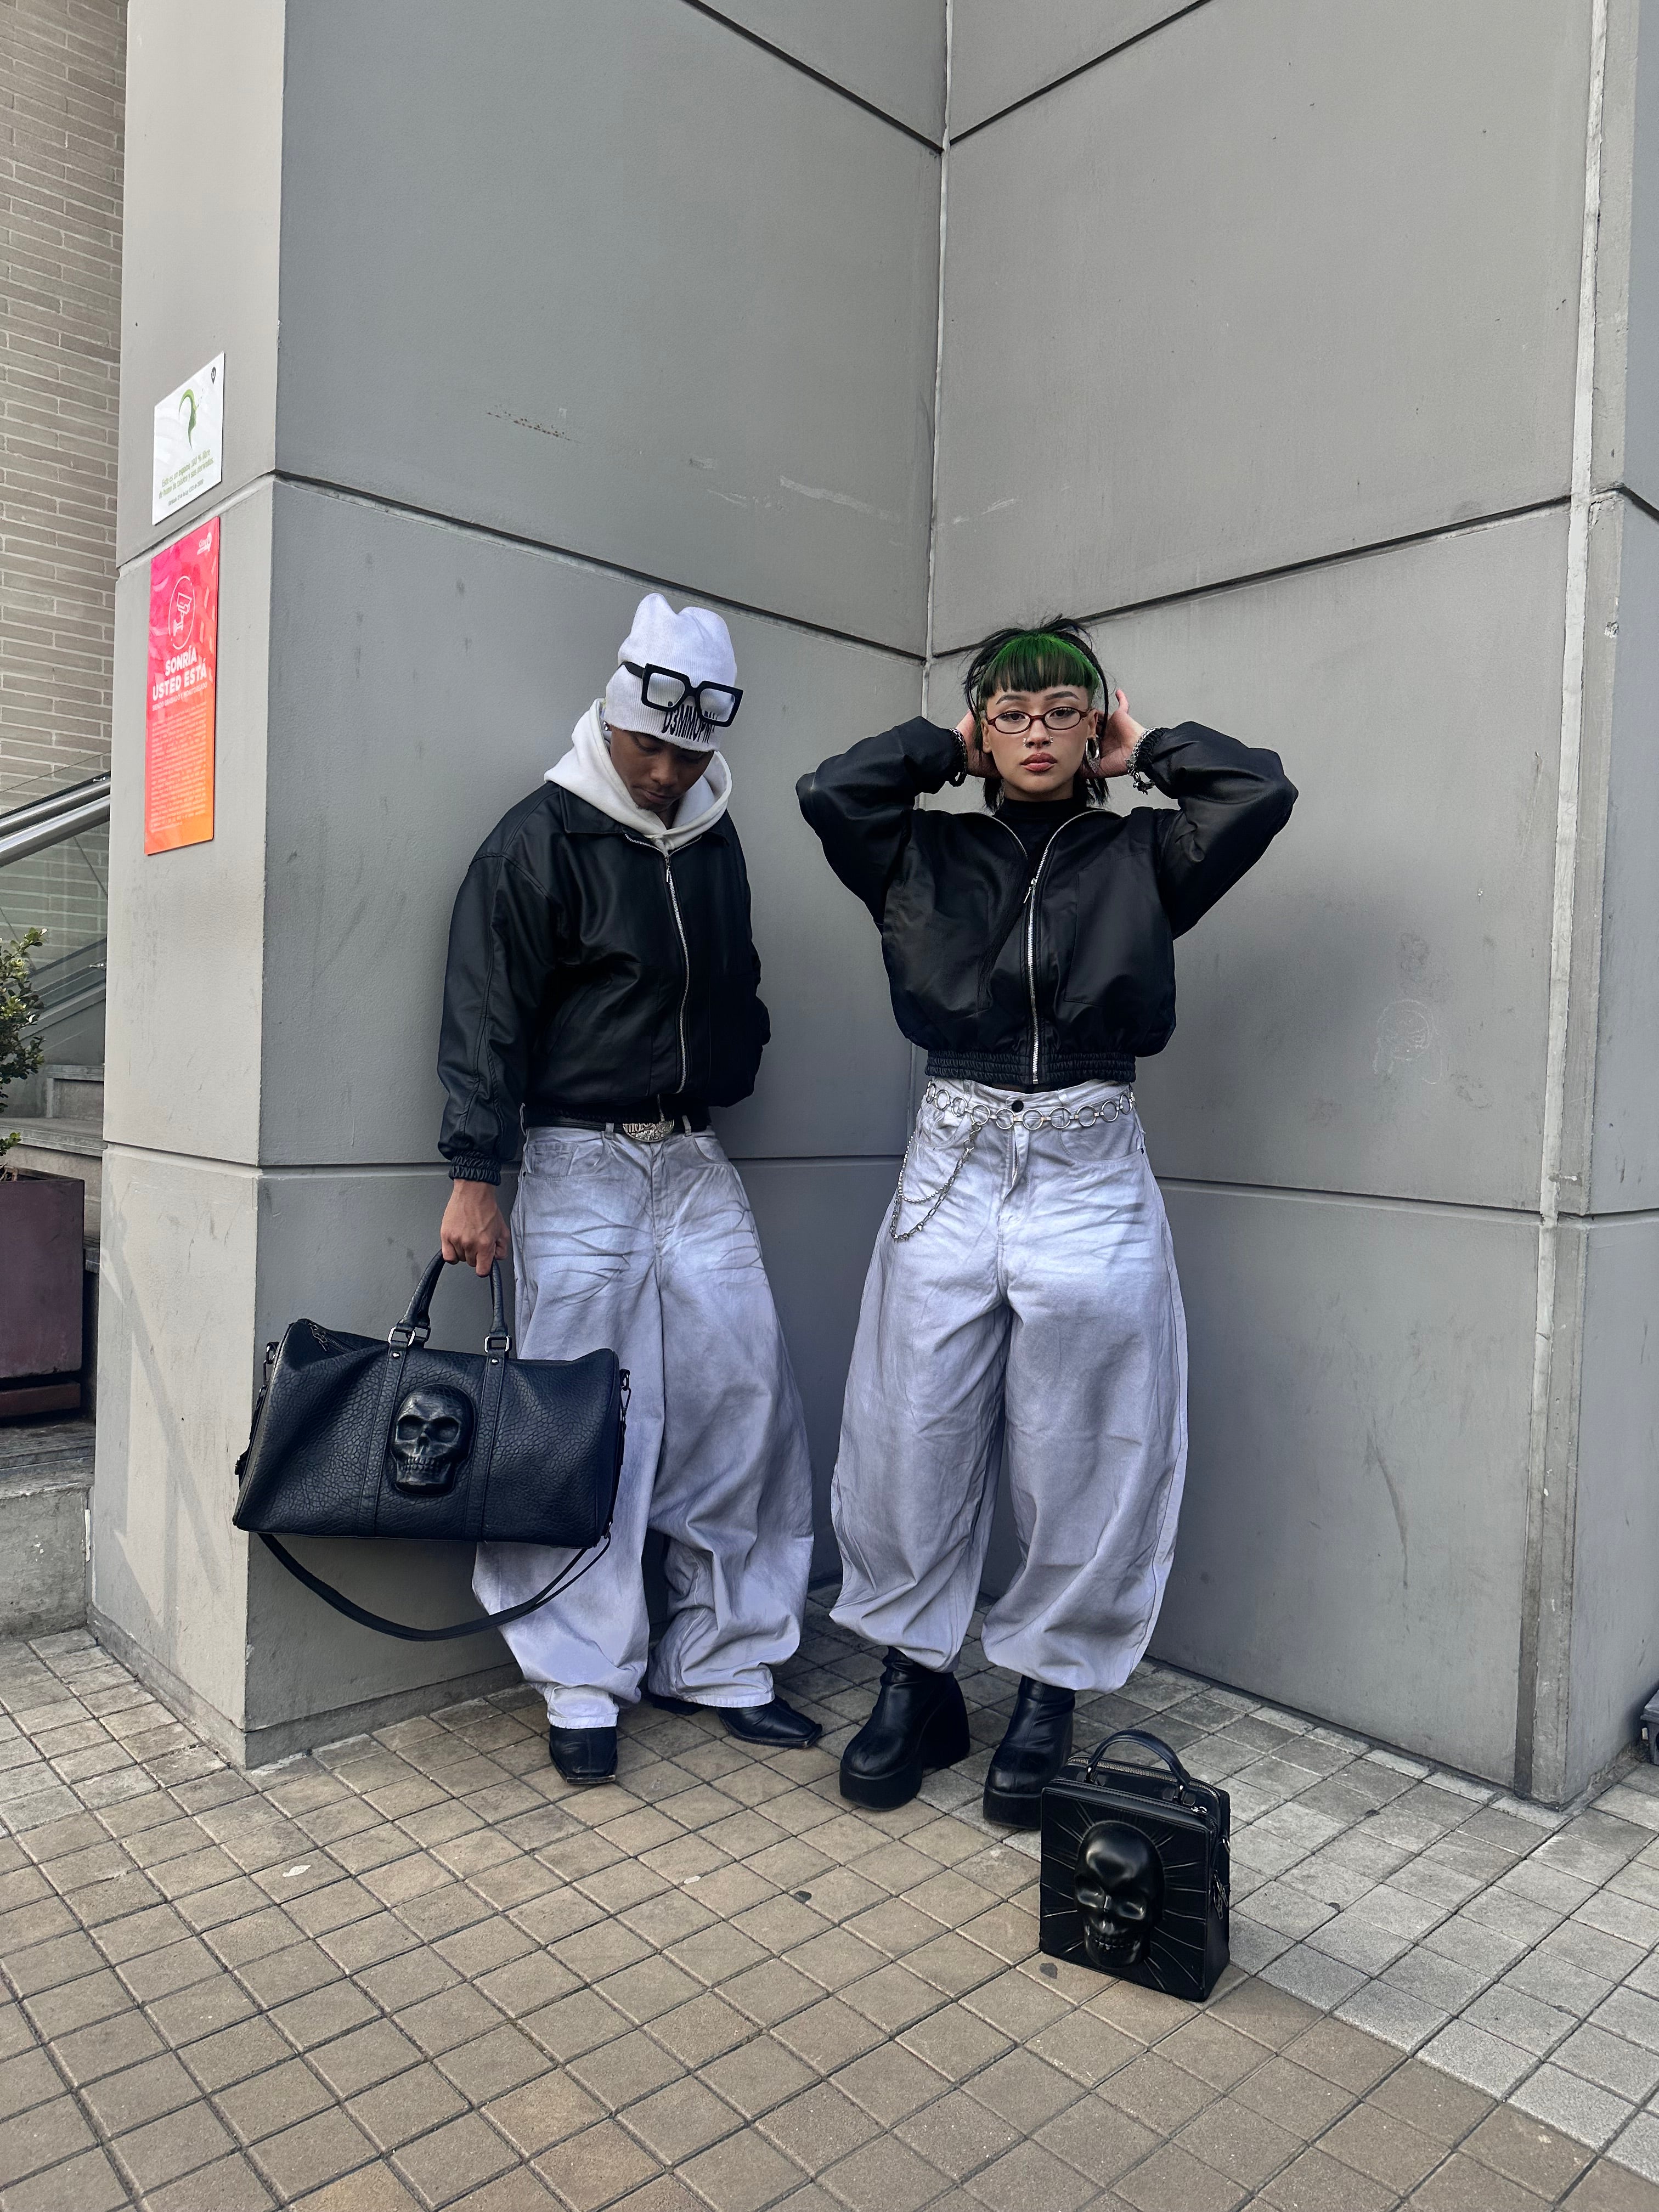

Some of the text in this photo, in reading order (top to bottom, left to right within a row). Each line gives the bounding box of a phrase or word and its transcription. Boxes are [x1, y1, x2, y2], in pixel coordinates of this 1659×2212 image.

[165, 645, 197, 676] SONRÍA
[152, 658, 207, 701] USTED ESTÁ
[165, 694, 180, 706] GRABADO
